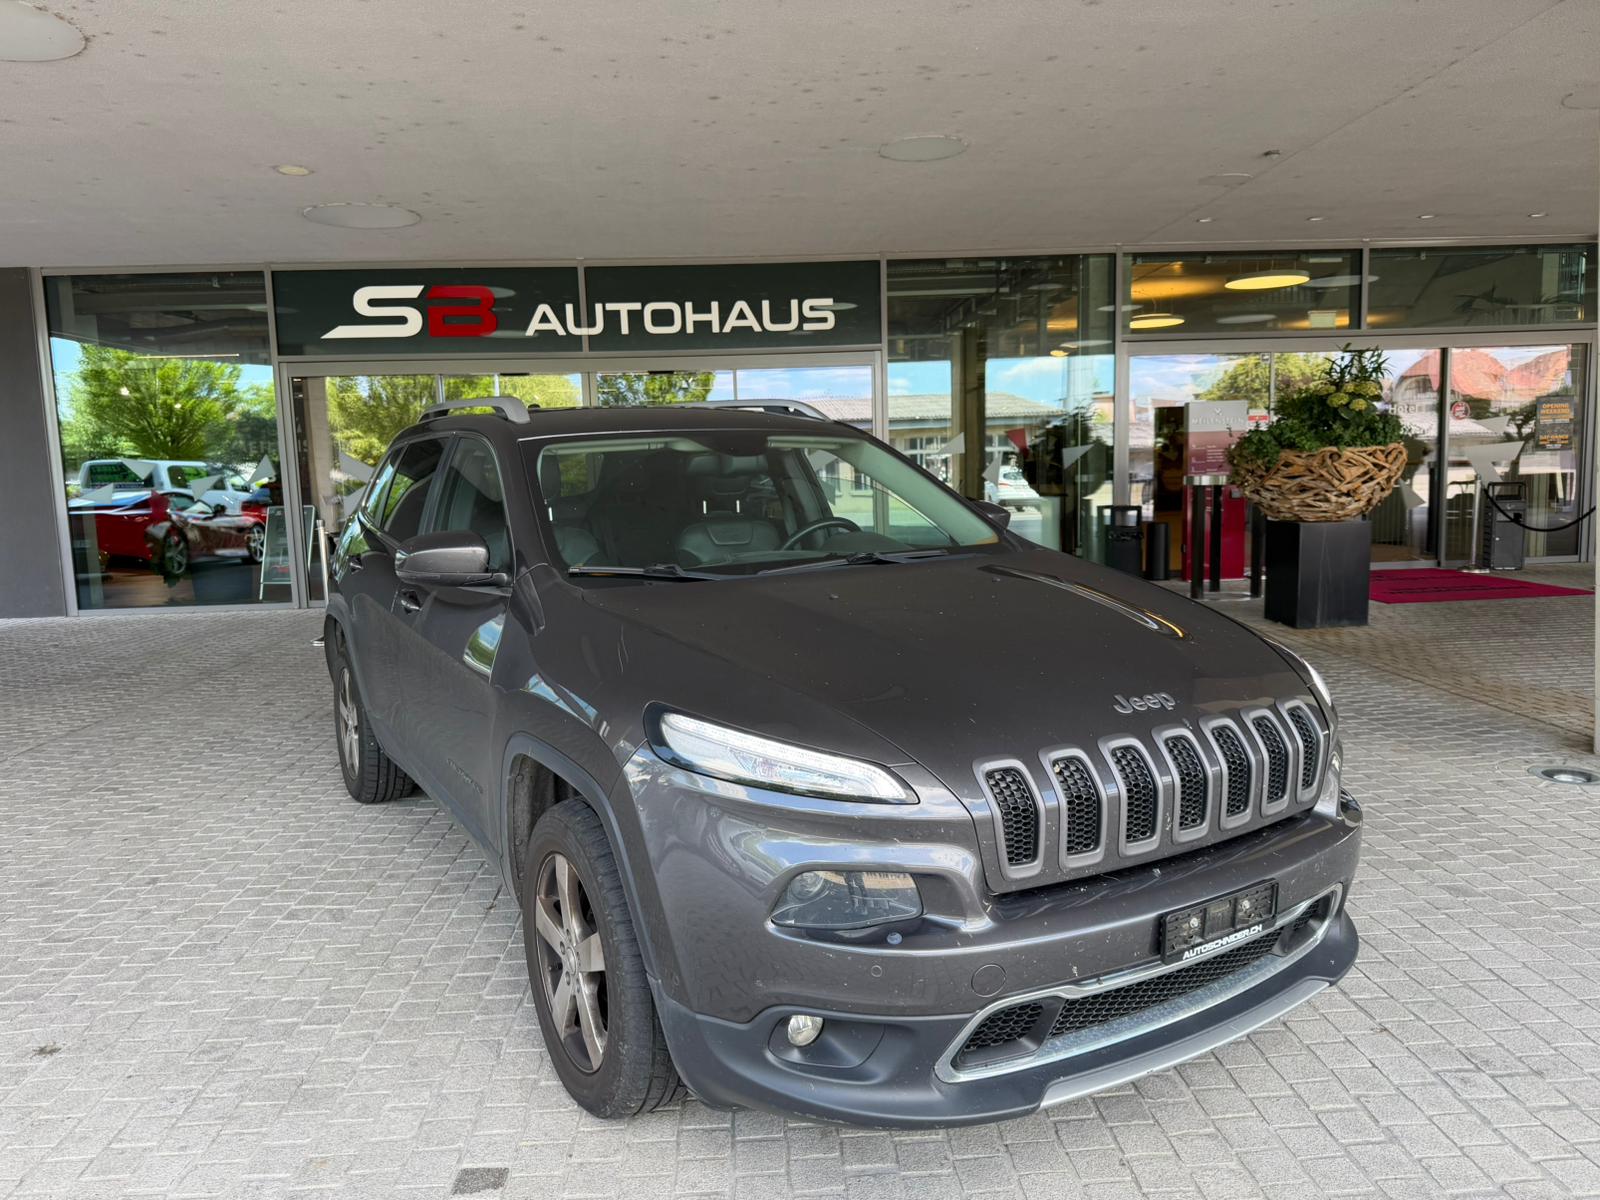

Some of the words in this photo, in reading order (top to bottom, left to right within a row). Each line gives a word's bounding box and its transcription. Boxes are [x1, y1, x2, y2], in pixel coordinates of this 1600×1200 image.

[525, 298, 834, 337] AUTOHAUS
[1389, 404, 1418, 415] Hotel
[1113, 692, 1176, 714] Jeep
